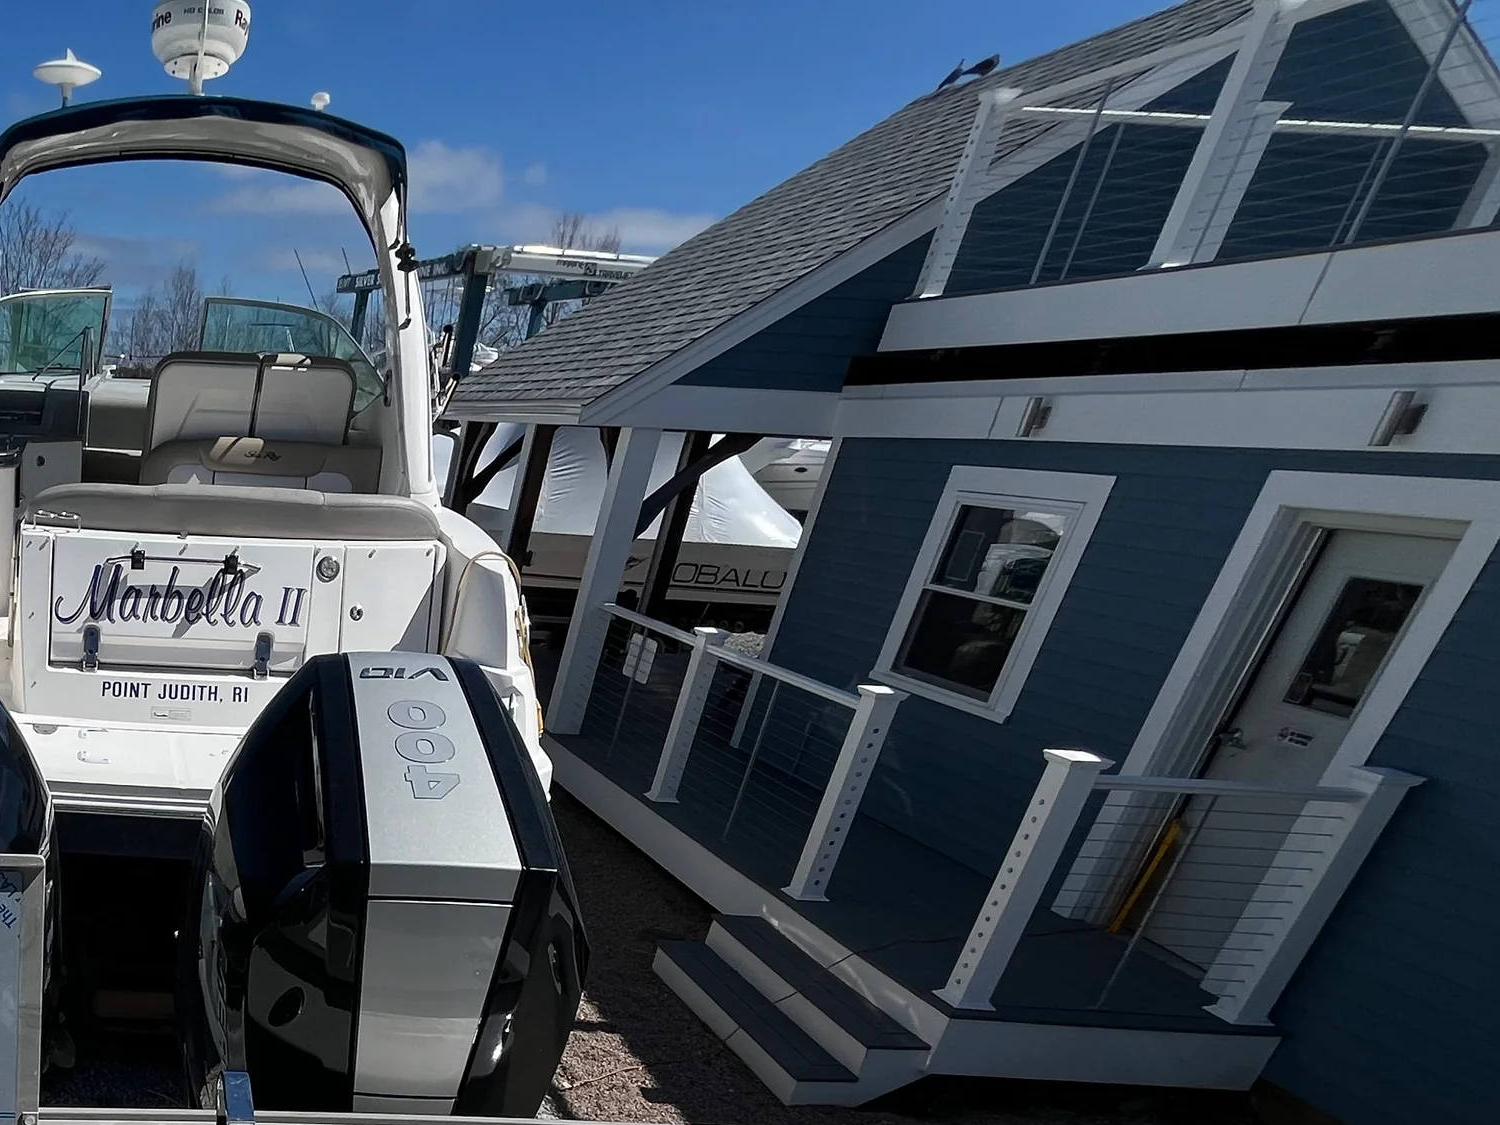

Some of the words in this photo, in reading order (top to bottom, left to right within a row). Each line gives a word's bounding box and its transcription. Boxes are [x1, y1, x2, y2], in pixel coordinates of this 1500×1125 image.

[197, 7, 225, 15] CLOR
[54, 564, 264, 628] Marbella
[274, 586, 308, 628] II
[359, 667, 449, 681] V10
[101, 681, 151, 699] POINT
[158, 683, 223, 704] JUDITH,
[232, 686, 248, 703] RI
[387, 700, 461, 800] 400
